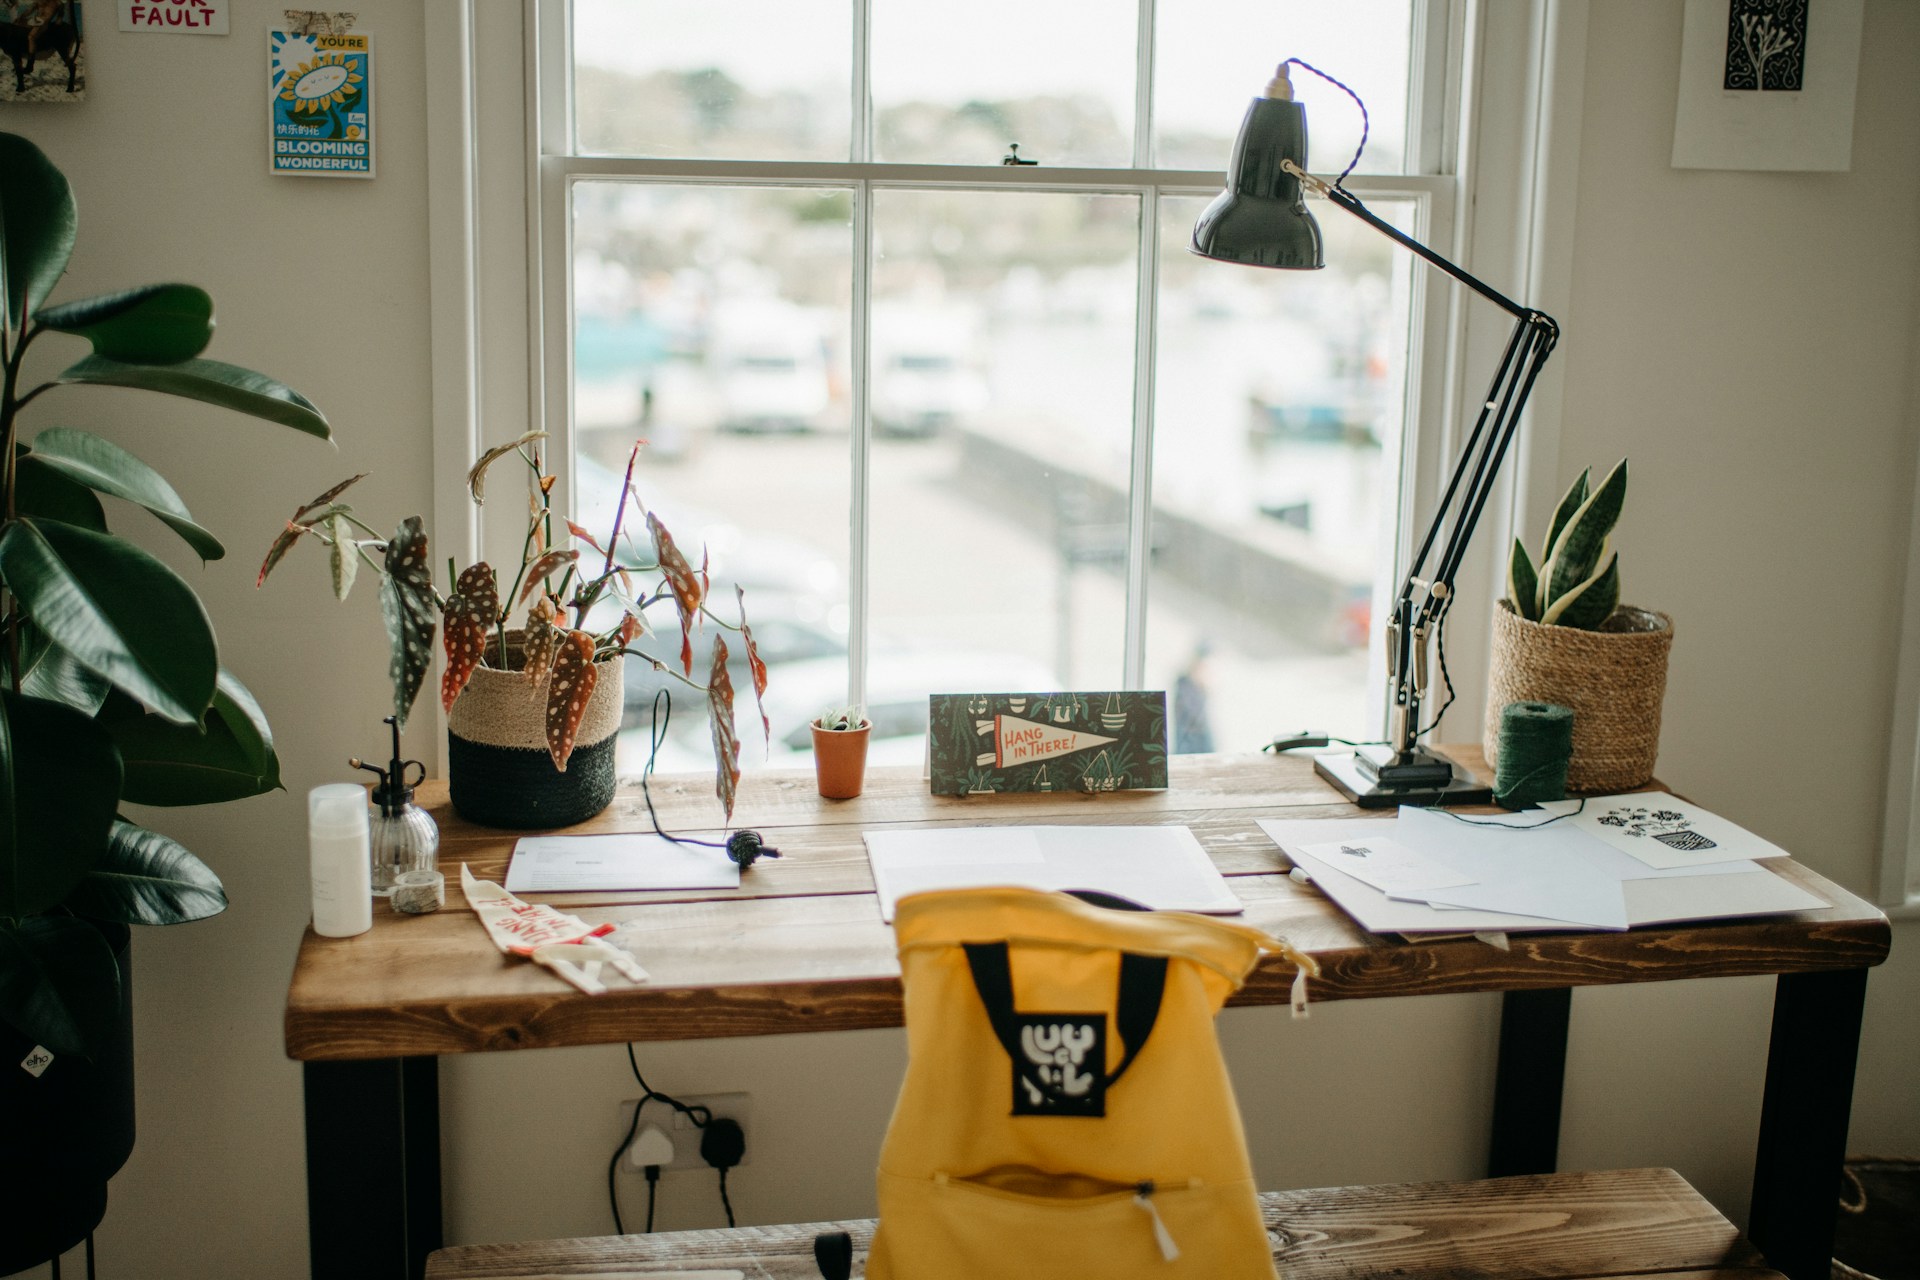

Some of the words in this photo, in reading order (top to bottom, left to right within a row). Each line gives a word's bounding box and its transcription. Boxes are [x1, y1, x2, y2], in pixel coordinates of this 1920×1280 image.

[131, 6, 215, 27] FAULT
[320, 37, 363, 48] YOU'RE
[276, 123, 320, 136] 快乐的花
[276, 141, 366, 155] BLOOMING
[277, 157, 367, 170] WONDERFUL
[1005, 728, 1043, 749] HANG
[1014, 747, 1027, 758] IN
[1027, 734, 1077, 757] THERE!
[26, 1054, 49, 1067] elho
